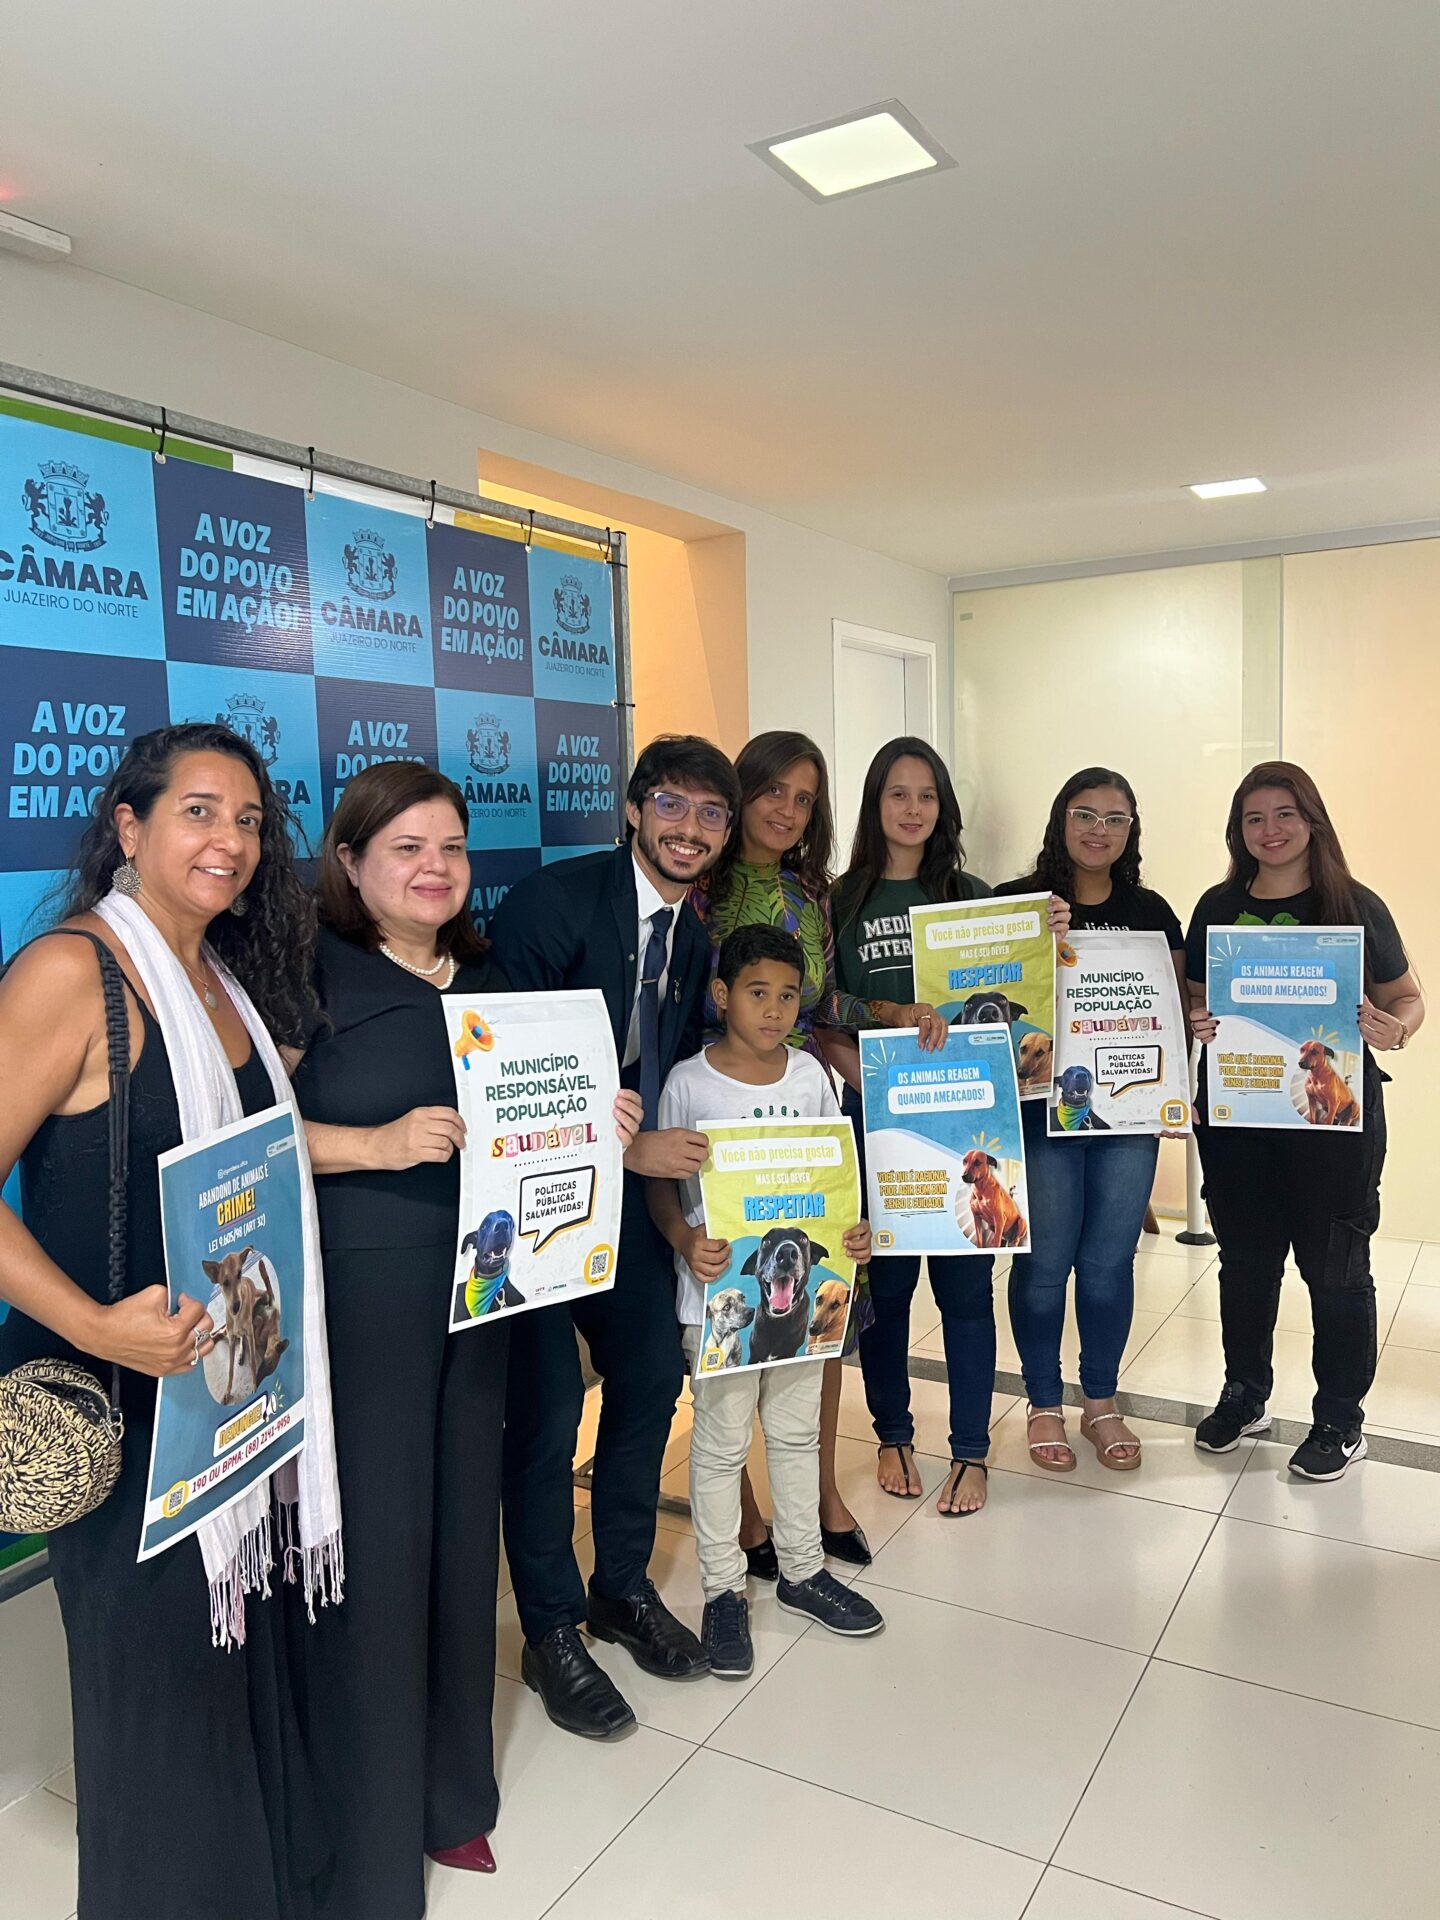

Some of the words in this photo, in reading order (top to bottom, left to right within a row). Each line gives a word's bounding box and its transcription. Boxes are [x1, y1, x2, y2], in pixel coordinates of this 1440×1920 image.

[195, 513, 215, 544] A
[219, 516, 271, 554] VOZ
[180, 547, 219, 581] DO
[224, 555, 293, 593] POVO
[453, 566, 467, 592] A
[469, 569, 505, 598] VOZ
[4, 589, 69, 610] JUAZEIRO
[73, 598, 94, 613] DO
[97, 601, 139, 618] NORTE
[177, 585, 217, 620] EM
[220, 591, 302, 634] AÇÃO!
[443, 596, 469, 622] DO
[472, 601, 520, 631] POVO
[321, 595, 423, 638] CÂMARA
[330, 632, 372, 648] JUAZEIRO
[374, 638, 388, 649] DO
[390, 641, 417, 653] NORTE
[441, 627, 468, 654] EM
[470, 629, 524, 664] AÇÃO!
[538, 631, 610, 665] CÂMARA
[544, 661, 574, 674] JUAZEIRO
[575, 665, 585, 675] DO
[586, 667, 606, 678] NORTE
[31, 701, 57, 733] A
[62, 702, 126, 736] VOZ
[347, 720, 364, 746] A
[367, 721, 409, 748] VOZ
[557, 734, 570, 756] A
[571, 735, 599, 758] VOZ
[13, 742, 62, 776] DO
[549, 761, 570, 784] DO
[572, 762, 611, 785] POVO
[9, 785, 59, 818] EM
[492, 808, 503, 818] DO
[504, 808, 527, 818] NORTE
[546, 790, 570, 812] EM
[570, 785, 615, 818] AÇÃO!
[470, 888, 483, 911] A
[932, 928, 954, 942] Você
[955, 926, 971, 939] não
[973, 922, 1005, 940] precisa
[1006, 920, 1034, 936] gostar
[960, 948, 974, 959] MAS
[979, 946, 990, 957] SEU
[991, 945, 1010, 956] DEVER
[948, 960, 1023, 990] RESPEITAR
[1080, 970, 1144, 984] MUNICÍPIO
[1241, 965, 1252, 977] OS
[1253, 965, 1289, 977] ANIMAIS
[1290, 965, 1324, 977] REAGEM
[1066, 984, 1159, 999] RESPONSÁVEL,
[1240, 984, 1272, 996] QUANDO
[1275, 985, 1327, 999] AMEAÇADOS!
[1074, 997, 1152, 1013] POPULAÇÃO
[500, 1053, 579, 1078] MUNICÍPIO
[1108, 1053, 1145, 1061] POLÍTICAS
[1109, 1060, 1144, 1068] PÚBLICAS
[485, 1073, 597, 1102] RESPONSÁVEL,
[897, 1072, 909, 1085] OS
[911, 1069, 946, 1084] ANIMAIS
[947, 1066, 980, 1081] REAGEM
[496, 1095, 587, 1123] POPULAÇÃO
[897, 1091, 931, 1106] QUANDO
[933, 1088, 985, 1104] AMEAÇADOS!
[721, 1147, 746, 1163] Você
[748, 1146, 766, 1161] não
[769, 1145, 803, 1164] precisa
[806, 1145, 835, 1161] gostar
[199, 1181, 231, 1210] ABANDONO
[233, 1175, 241, 1193] DE
[241, 1165, 264, 1189] ANIMAIS
[264, 1160, 269, 1178] É
[755, 1173, 770, 1185] MAS
[777, 1172, 789, 1184] SEU
[790, 1172, 811, 1183] DEVER
[915, 1169, 950, 1182] RACIONAL,
[535, 1180, 577, 1197] POLÍTICAS
[536, 1191, 575, 1208] PÚBLICAS
[879, 1184, 898, 1196] PODE
[217, 1188, 256, 1226] CRIME!
[525, 1206, 557, 1221] SALVAM
[559, 1201, 584, 1214] VIDAS!
[743, 1192, 826, 1221] RESPEITAR
[208, 1239, 219, 1253] LEI
[219, 1226, 243, 1247] 9.605/98
[244, 1218, 256, 1236] (ART
[257, 1213, 266, 1229] 32)
[192, 1475, 207, 1493] 190
[209, 1465, 221, 1482] OU
[222, 1450, 244, 1473] BPMA:
[245, 1437, 259, 1458] (88)
